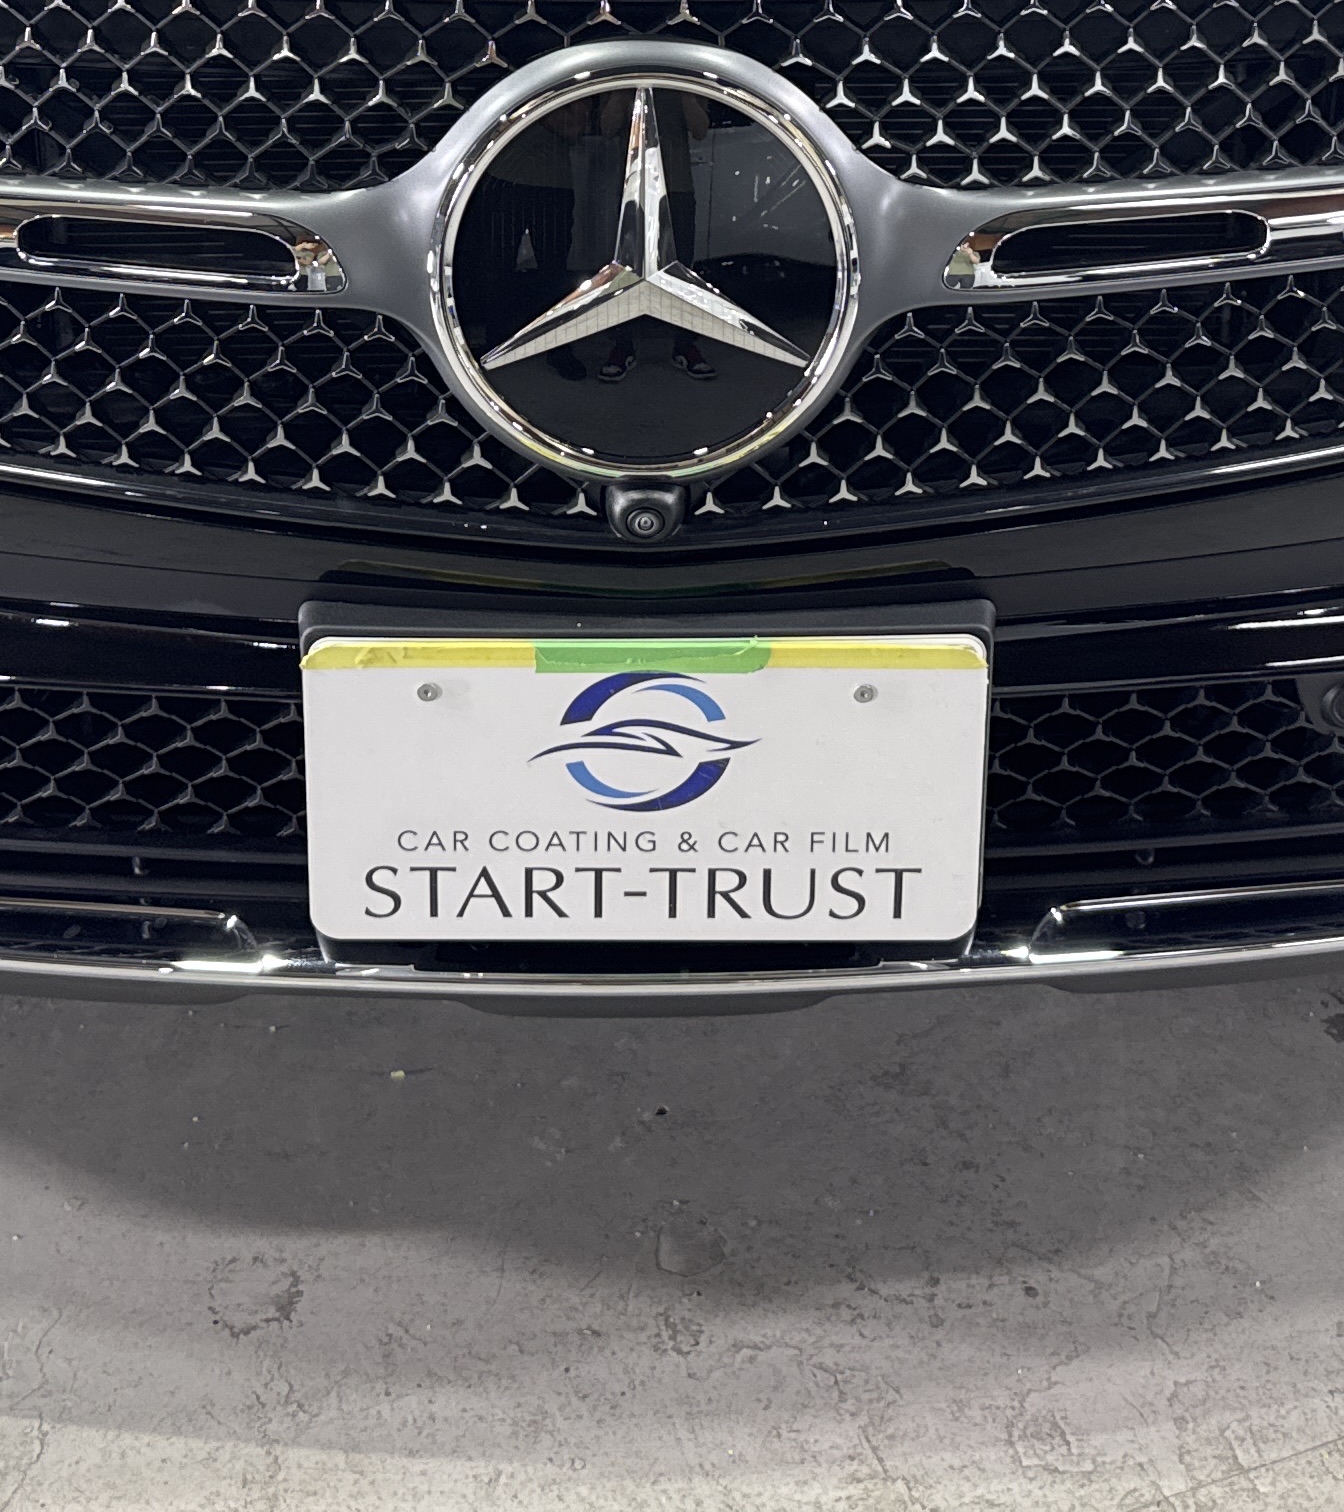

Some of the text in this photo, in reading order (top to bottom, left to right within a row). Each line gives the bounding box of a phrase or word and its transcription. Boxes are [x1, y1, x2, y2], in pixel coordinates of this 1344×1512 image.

[397, 830, 891, 853] CAR COATING & CAR FILM
[364, 865, 923, 920] START-TRUST
